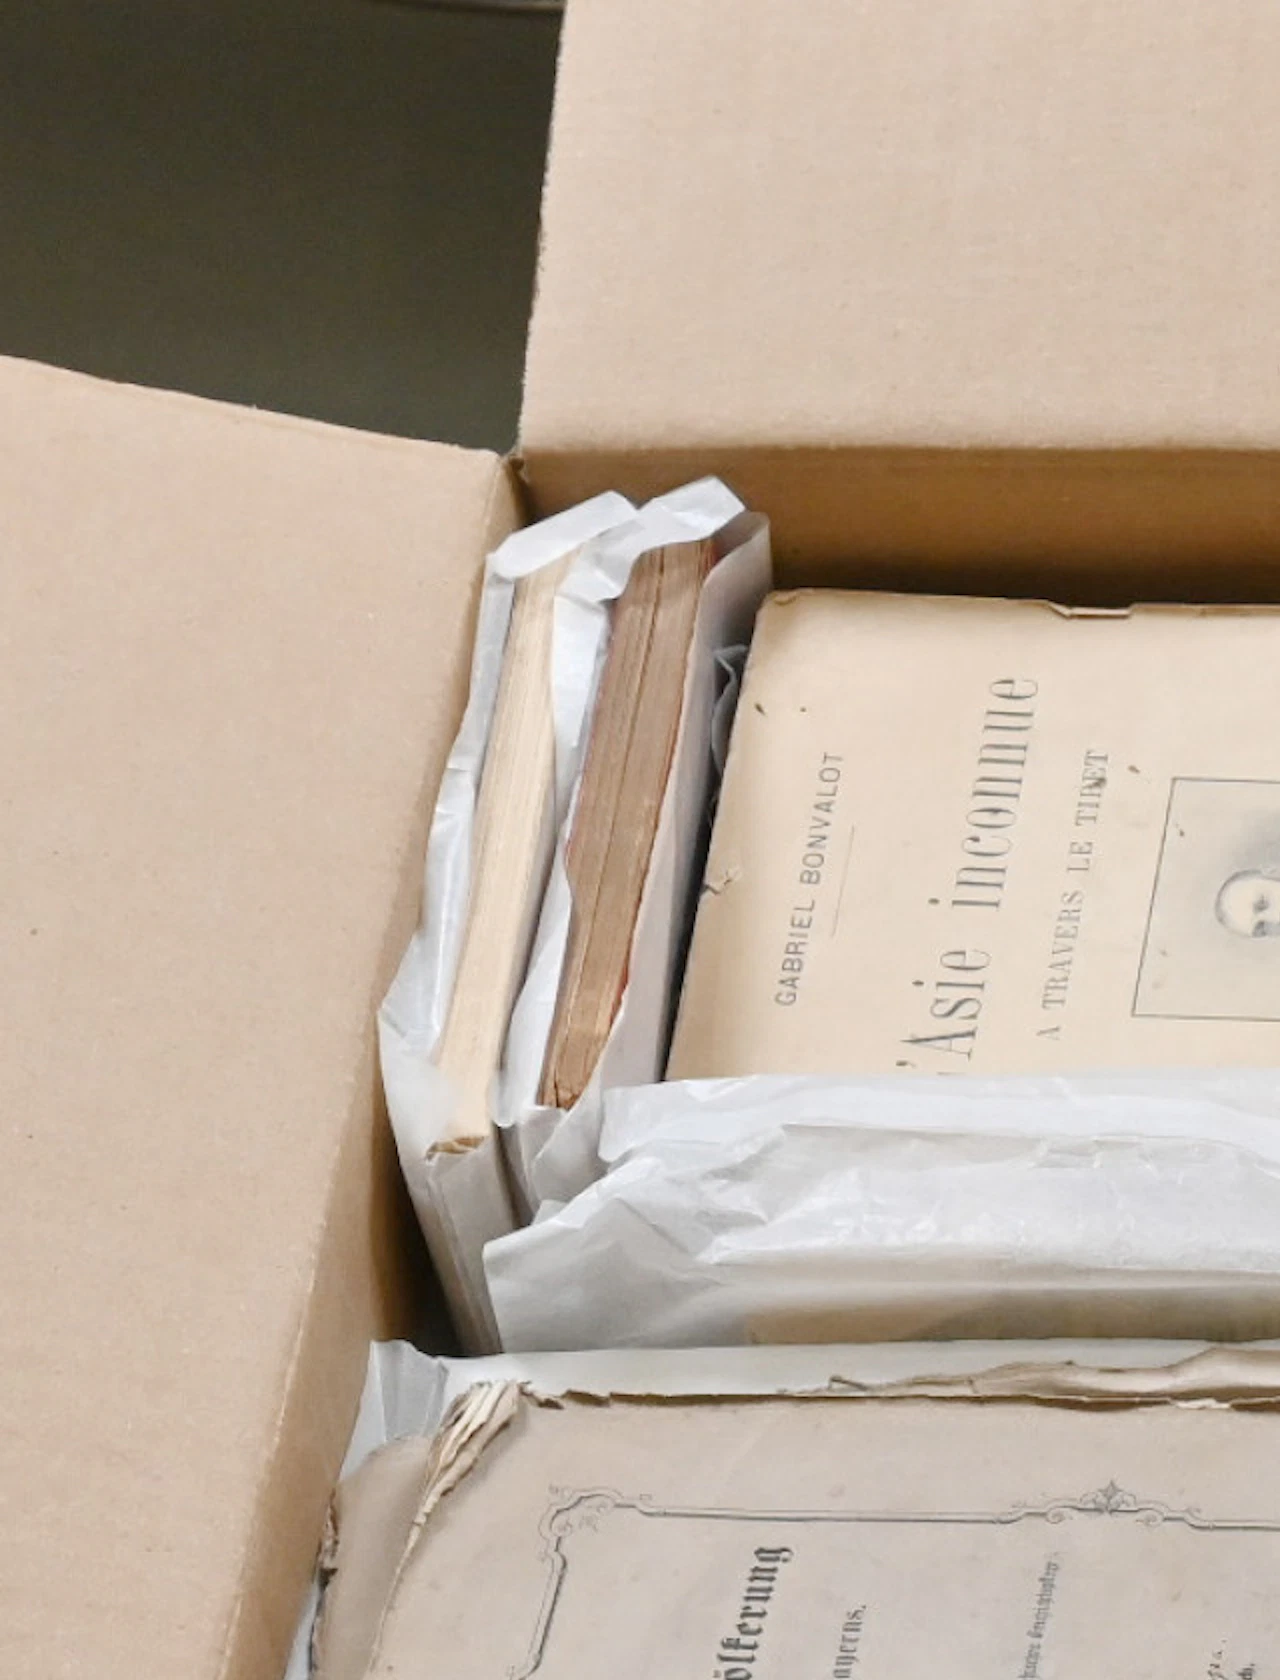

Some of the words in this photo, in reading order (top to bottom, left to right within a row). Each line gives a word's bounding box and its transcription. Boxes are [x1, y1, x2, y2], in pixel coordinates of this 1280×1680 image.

[928, 677, 1039, 910] inconnue
[1076, 749, 1110, 827] TIBET
[774, 898, 816, 1007] GABRIEL
[800, 751, 843, 886] BONVALOT
[1067, 840, 1093, 871] LE
[1043, 889, 1084, 1010] TRAVERS
[896, 948, 993, 1076] 'Asie
